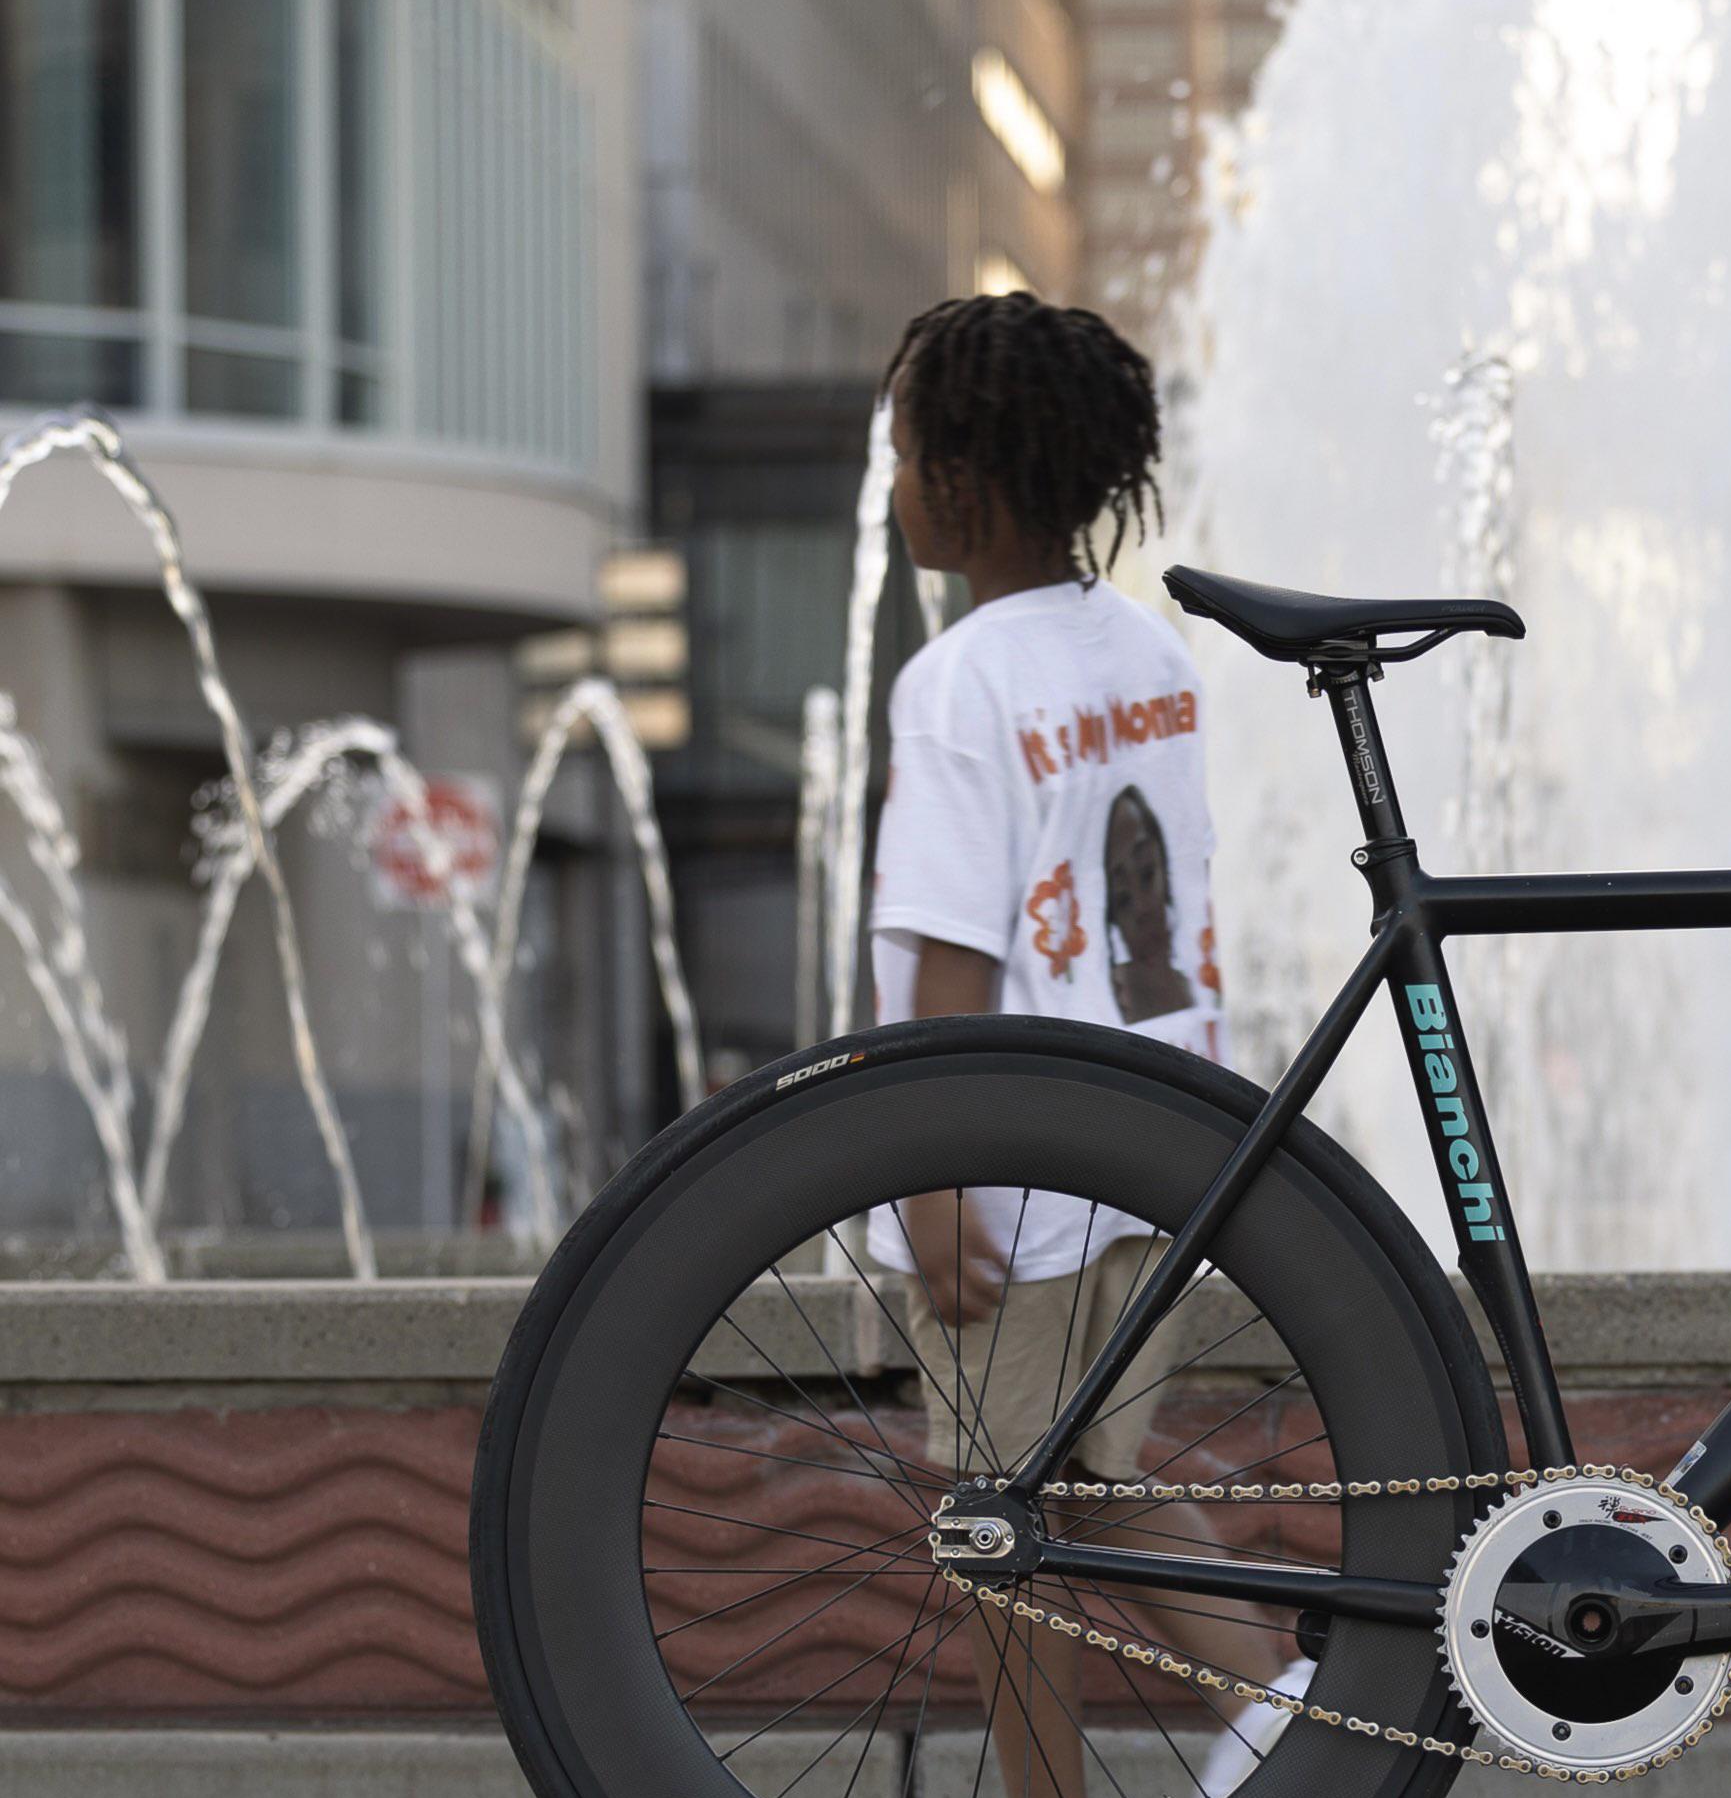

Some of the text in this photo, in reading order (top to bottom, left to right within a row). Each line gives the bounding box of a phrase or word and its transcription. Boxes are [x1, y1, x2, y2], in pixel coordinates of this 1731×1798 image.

[1344, 689, 1384, 805] THOMSON
[775, 1053, 851, 1092] 5000
[1405, 984, 1506, 1242] Bianchi
